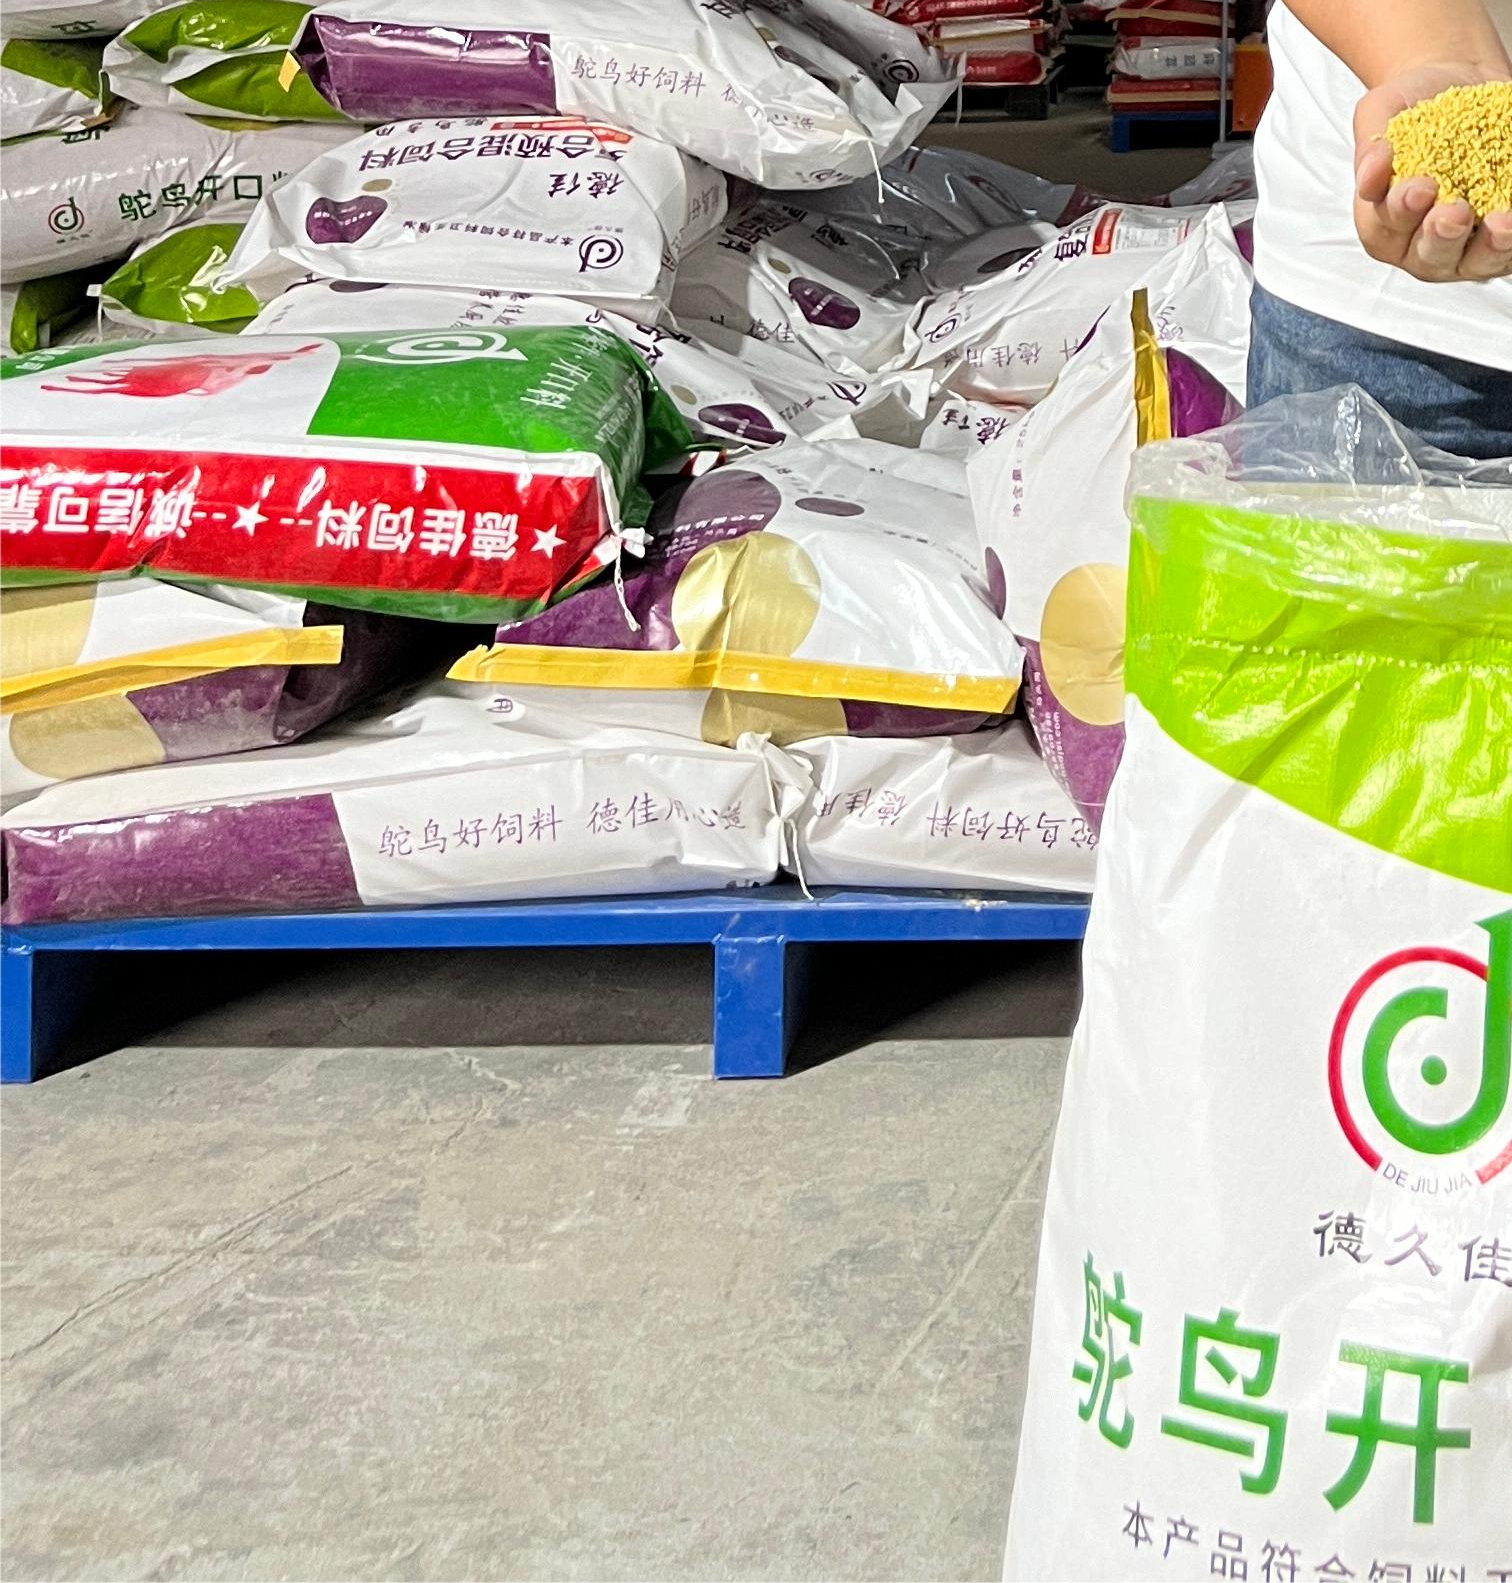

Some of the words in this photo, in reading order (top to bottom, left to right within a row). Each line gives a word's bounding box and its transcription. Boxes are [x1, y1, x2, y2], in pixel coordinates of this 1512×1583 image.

[570, 54, 707, 98] 鸵鸟好饲料
[118, 171, 288, 222] 鸵鸟开口
[315, 497, 521, 563] 德佳饲料
[378, 804, 564, 858] 鸵鸟好饲料
[1382, 1162, 1409, 1189] DE
